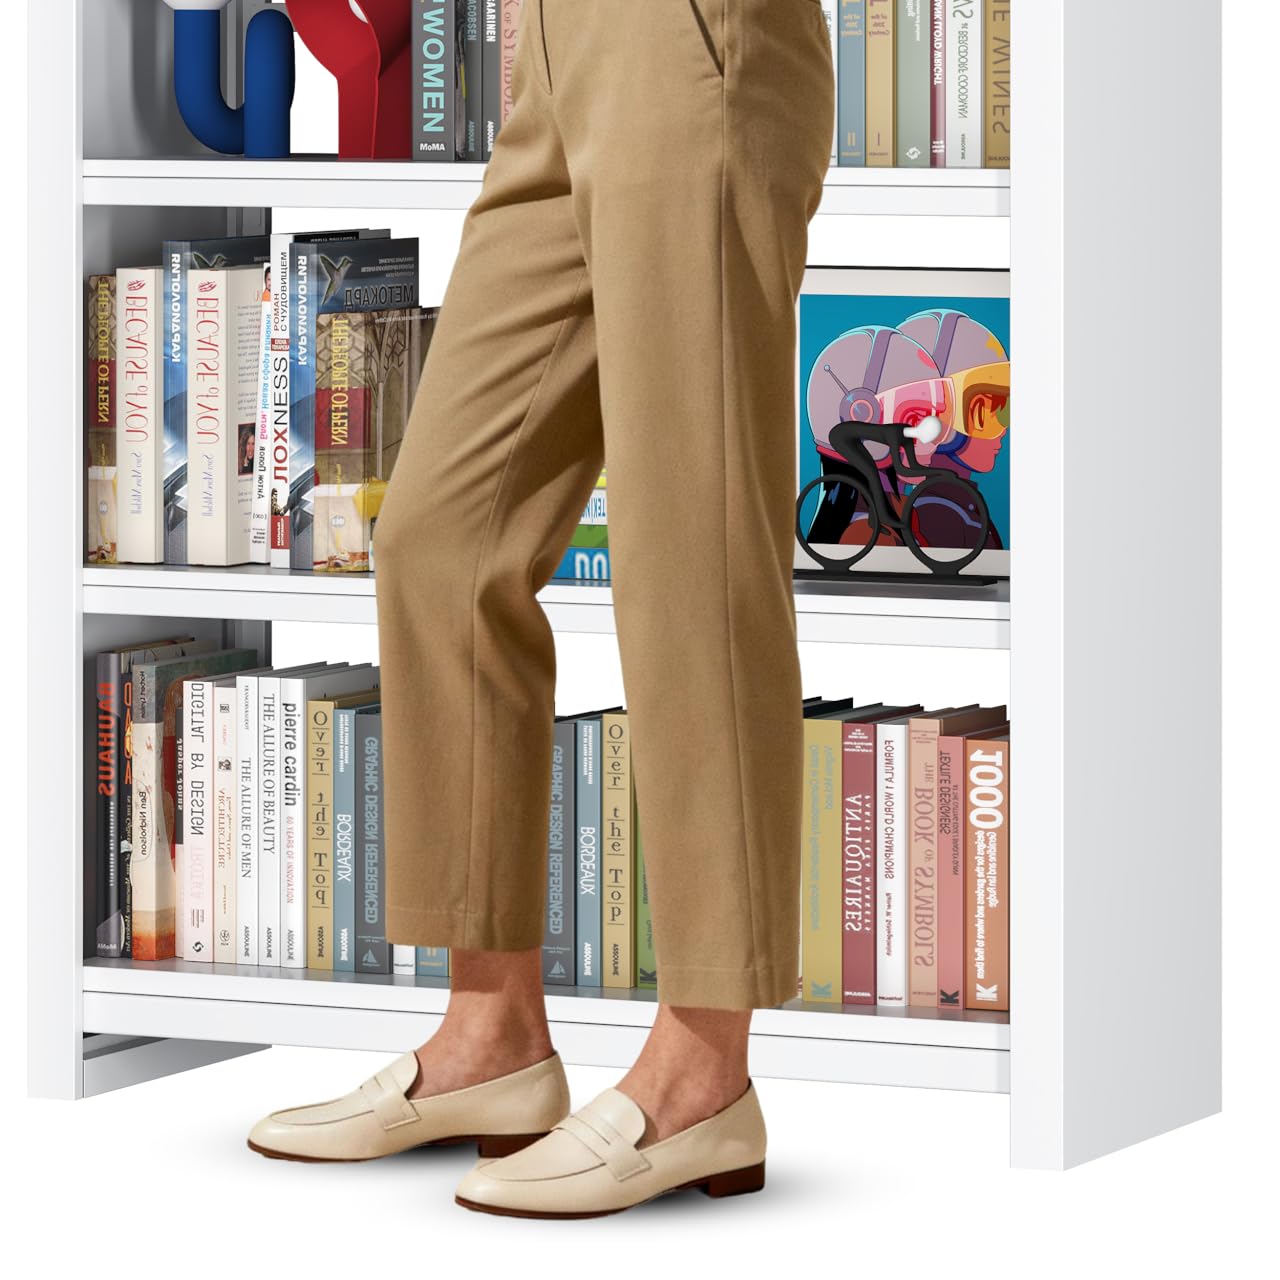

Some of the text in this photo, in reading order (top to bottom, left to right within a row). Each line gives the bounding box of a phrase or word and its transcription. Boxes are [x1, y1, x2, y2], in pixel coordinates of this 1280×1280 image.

[423, 7, 445, 132] WOMEN
[263, 694, 275, 855] THE ALLURE OF BEAUTY
[283, 703, 301, 806] pierre cardin
[580, 827, 595, 895] BORDEAUX
[609, 724, 625, 921] Over the Top
